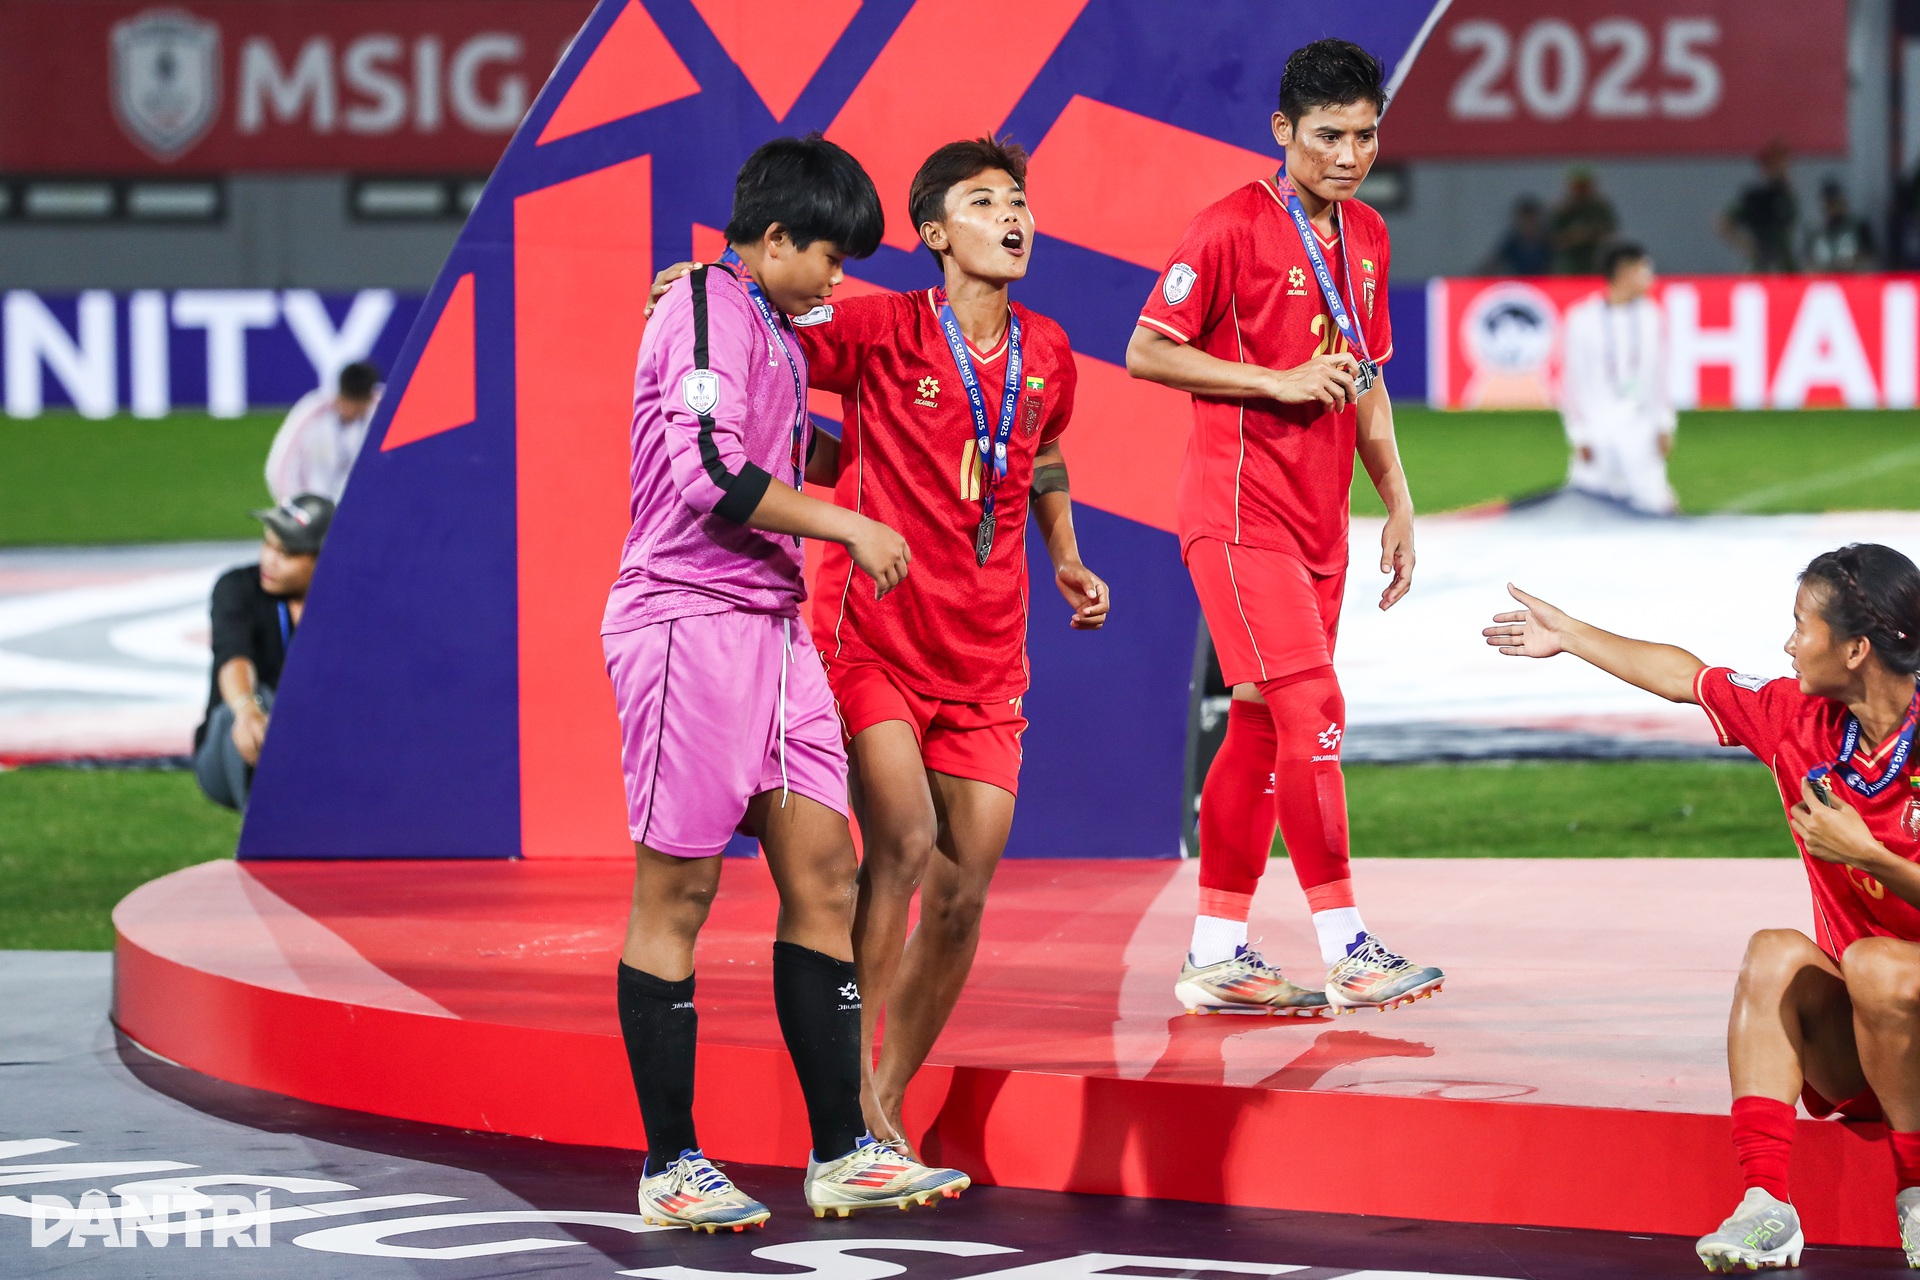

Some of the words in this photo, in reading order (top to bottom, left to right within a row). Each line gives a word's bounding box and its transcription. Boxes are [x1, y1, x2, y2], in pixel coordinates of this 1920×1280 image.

[237, 34, 527, 134] MSIG
[1449, 18, 1722, 120] 2025
[1292, 209, 1308, 230] MSIG
[1302, 231, 1323, 271] SERENITY
[1319, 271, 1331, 288] CUP
[1327, 291, 1341, 310] 2025
[755, 296, 769, 318] MSIG
[1011, 325, 1021, 348] MSIG
[945, 320, 960, 342] MSIG
[953, 343, 976, 386] SERENITY
[969, 388, 981, 407] CUP
[975, 409, 986, 431] 2025
[1009, 348, 1020, 392] SERENITY
[1005, 393, 1015, 413] CUP
[1000, 415, 1011, 437] 2025
[1894, 739, 1910, 763] MSIG
[1868, 763, 1900, 792] SERENITY
[1743, 1217, 1786, 1250] F50
